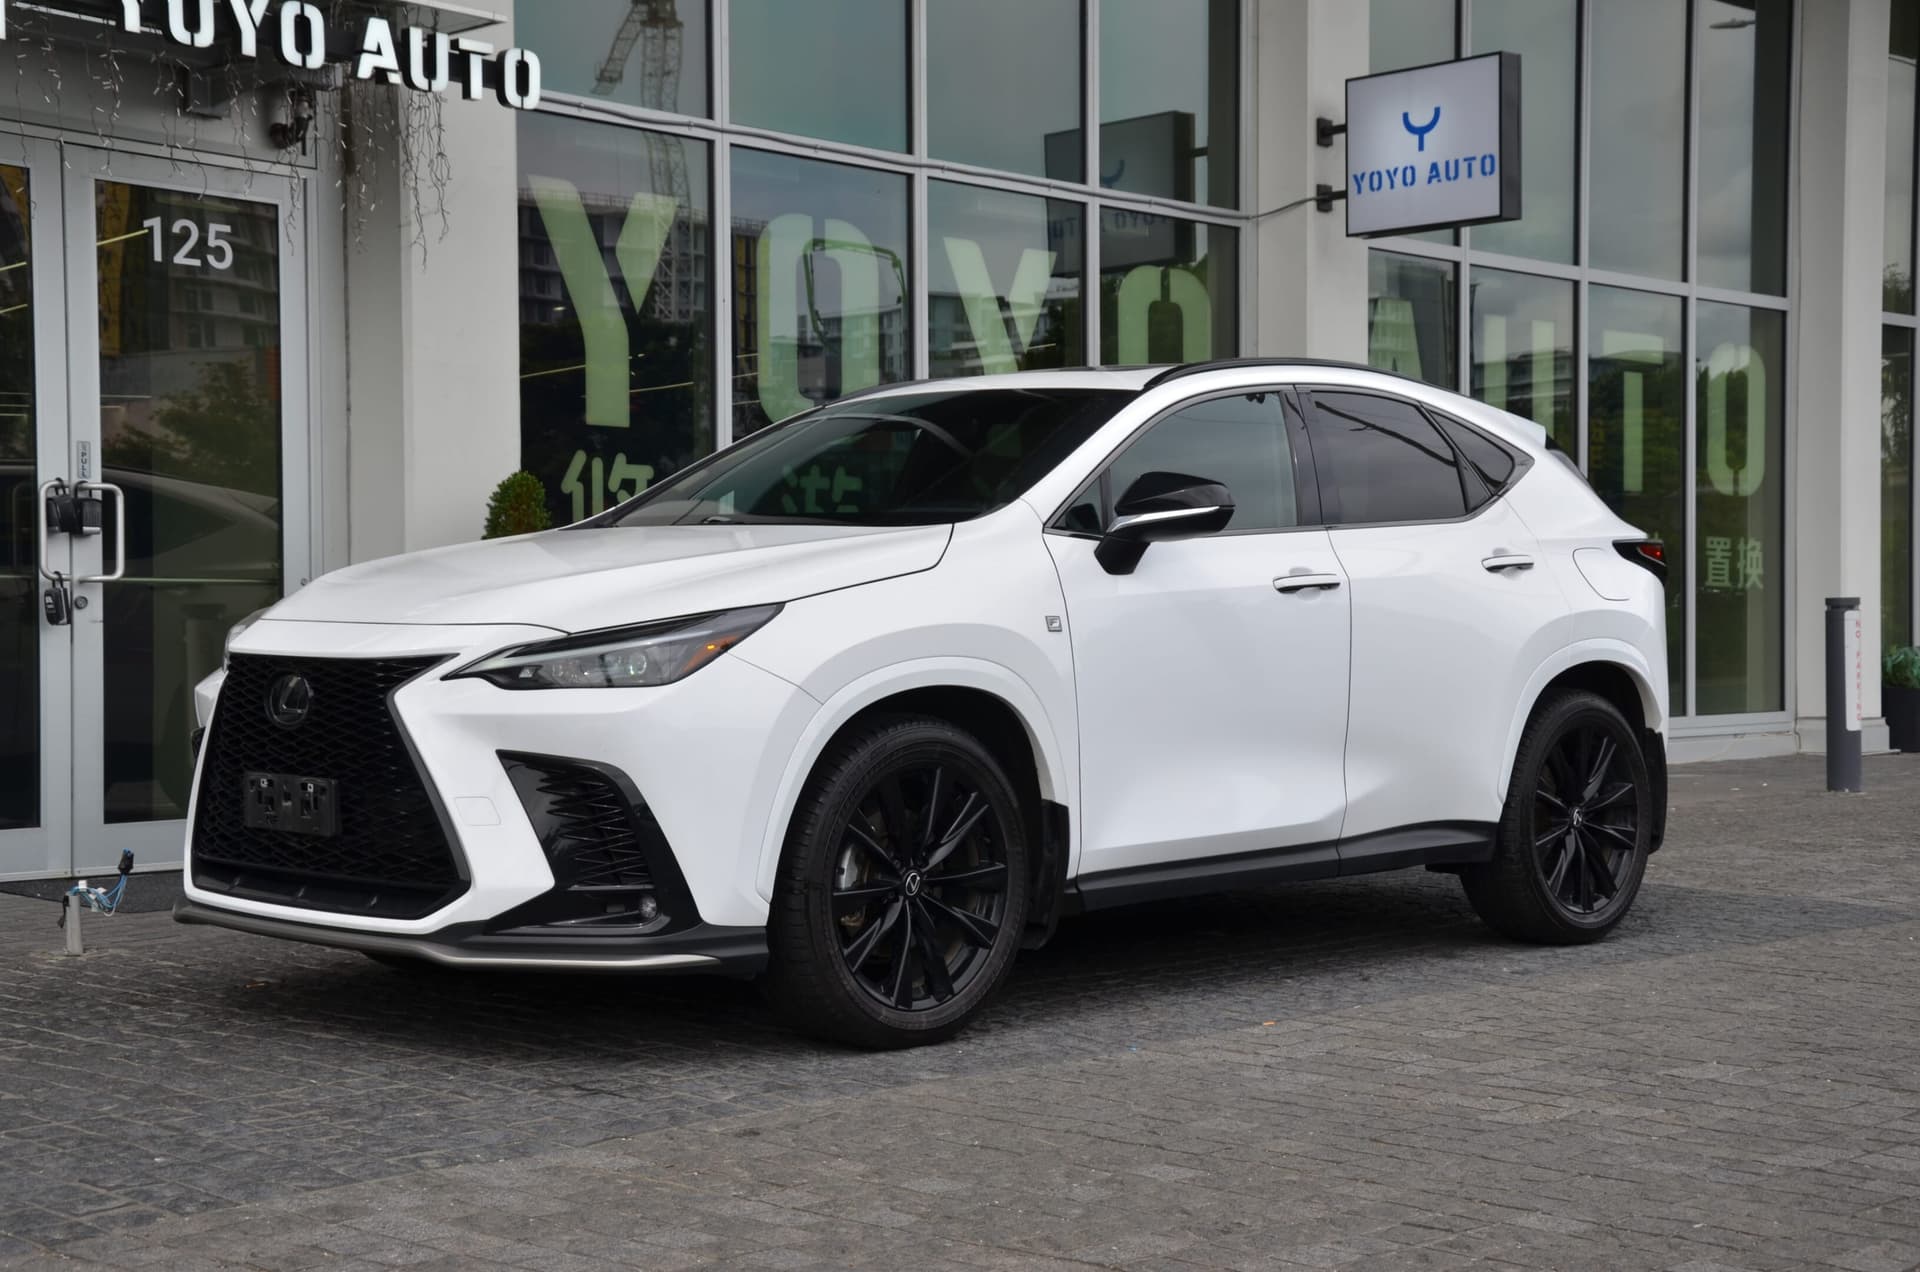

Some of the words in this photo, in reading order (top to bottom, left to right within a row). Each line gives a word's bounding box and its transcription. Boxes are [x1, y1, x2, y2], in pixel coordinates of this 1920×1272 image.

[356, 17, 541, 110] AUTO
[1352, 165, 1416, 195] YOYO
[1427, 153, 1496, 185] AUTO
[143, 216, 233, 270] 125
[1705, 536, 1764, 590] 置换
